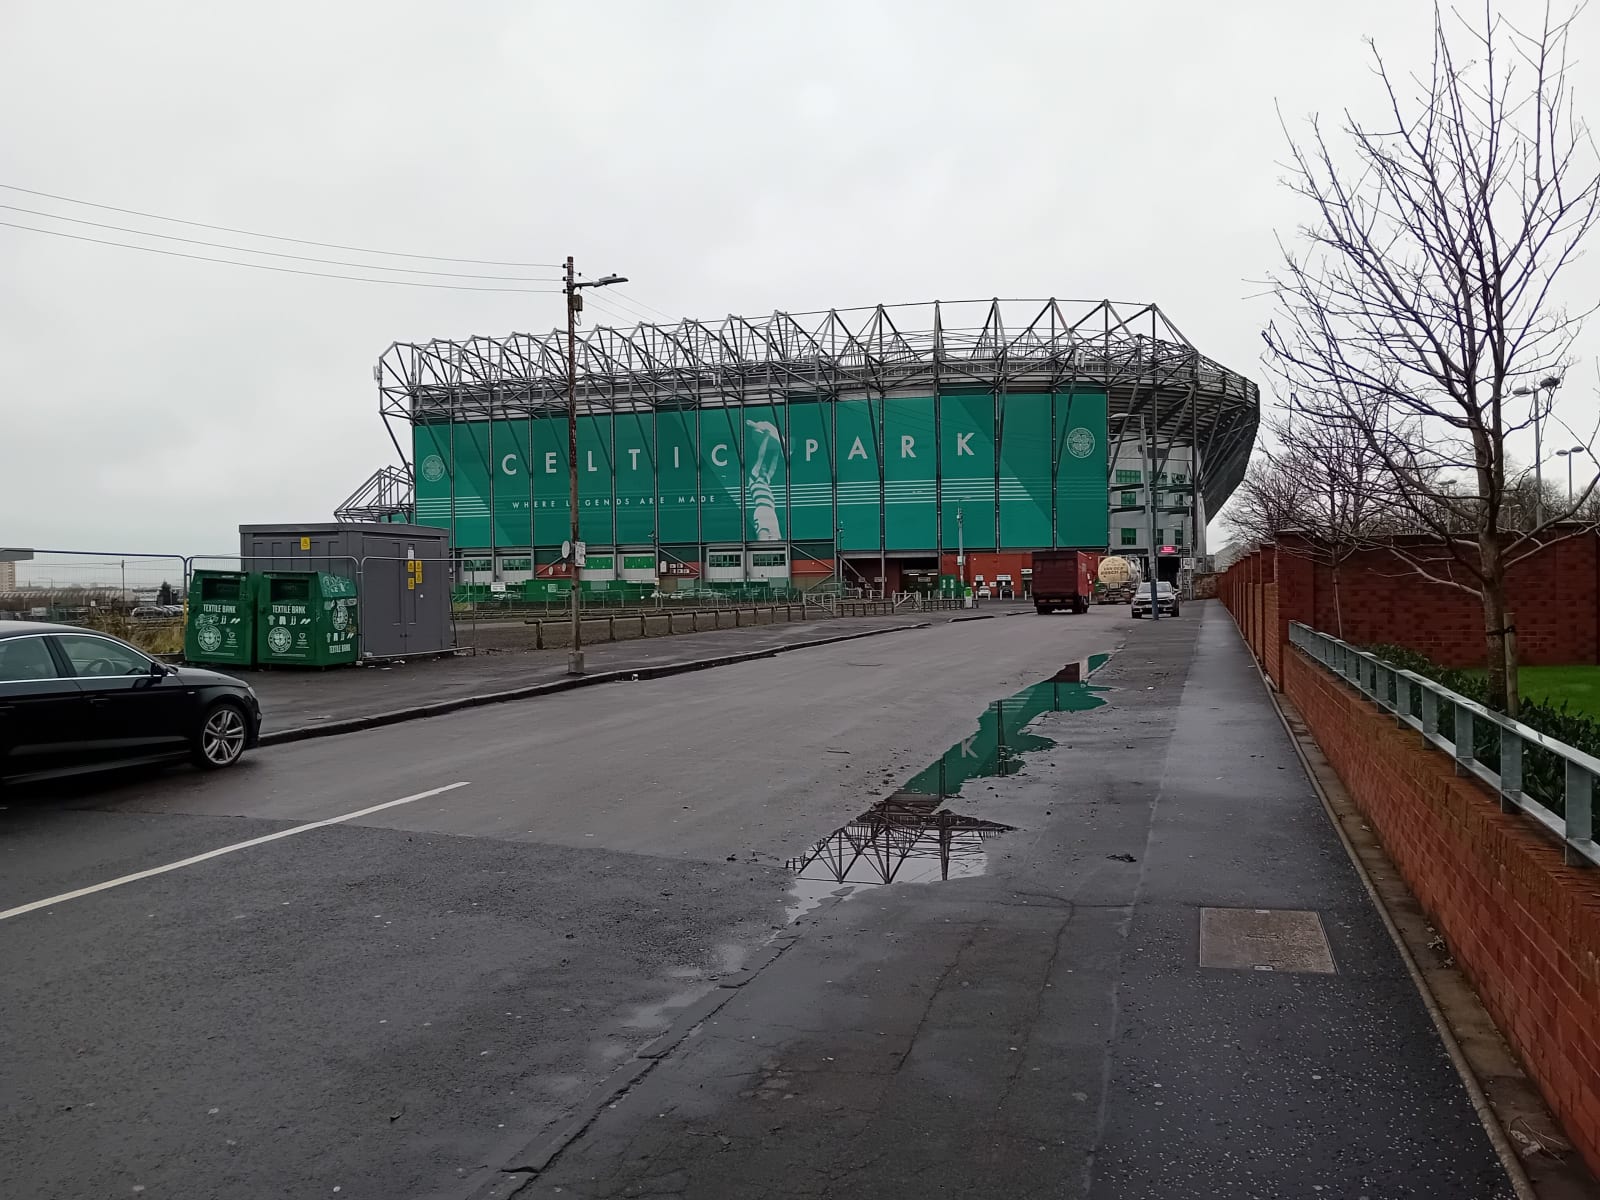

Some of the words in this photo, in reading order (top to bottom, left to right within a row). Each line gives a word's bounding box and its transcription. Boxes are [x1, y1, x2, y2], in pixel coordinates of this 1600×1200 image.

[501, 444, 728, 475] CELTIC
[805, 432, 976, 462] PARK
[512, 500, 556, 509] WHERE
[566, 498, 630, 507] LGENDS
[640, 496, 665, 505] ARE
[678, 495, 715, 503] MADE
[203, 603, 222, 613] TEXTILE
[222, 605, 237, 614] BANK
[272, 604, 291, 614] TEXTILE
[292, 605, 306, 614] BANK
